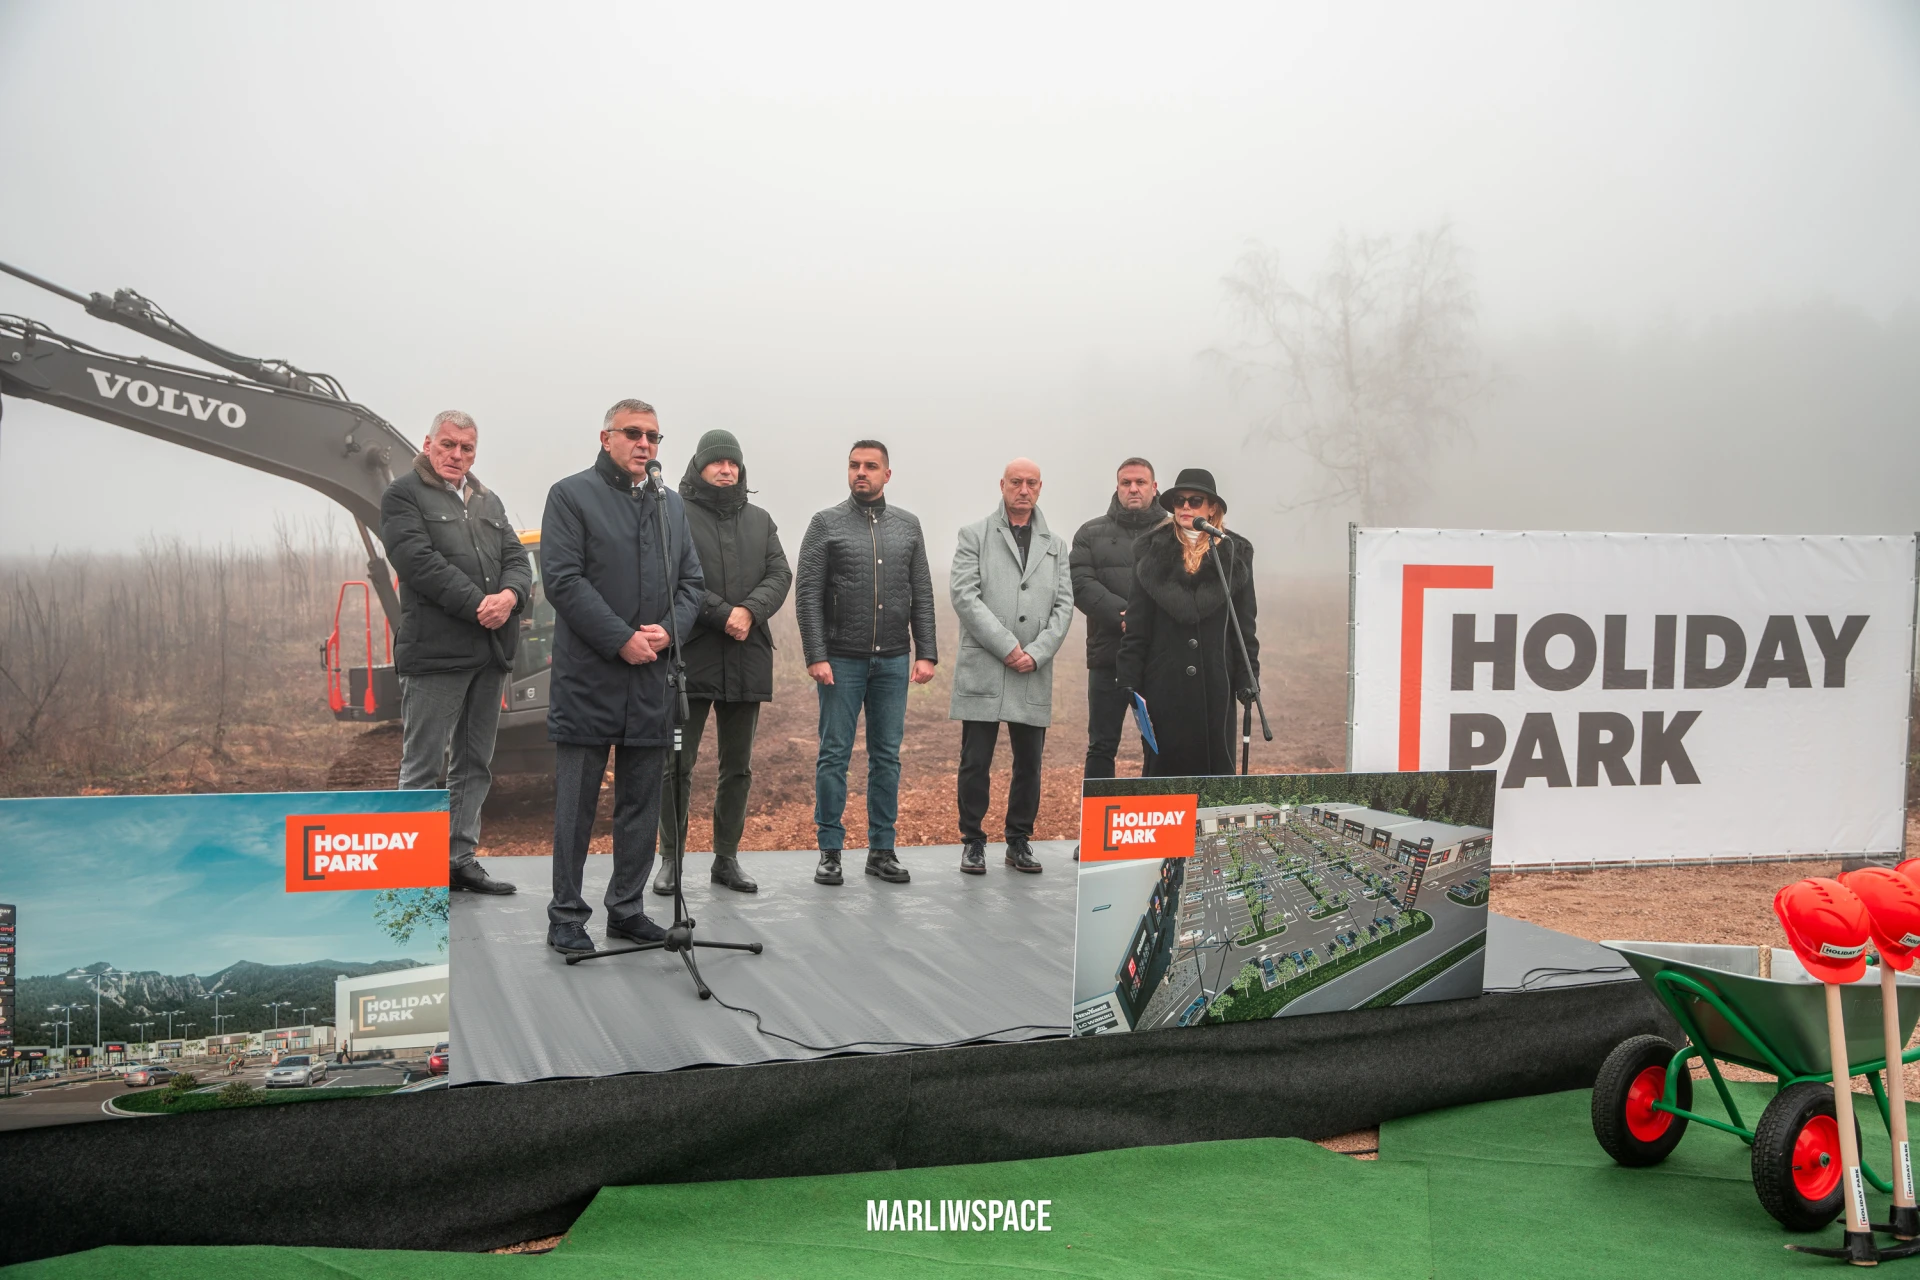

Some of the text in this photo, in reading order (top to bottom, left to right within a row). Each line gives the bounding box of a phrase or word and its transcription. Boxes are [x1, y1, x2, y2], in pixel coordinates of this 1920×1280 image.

[86, 367, 247, 429] VOLVO
[1450, 612, 1871, 692] HOLIDAY
[1449, 710, 1703, 789] PARK
[1112, 811, 1186, 828] HOLIDAY
[314, 832, 419, 852] HOLIDAY
[1111, 828, 1157, 845] PARK
[314, 853, 379, 873] PARK
[1825, 947, 1857, 956] HOLIDAY
[367, 992, 446, 1012] HOLIDAY
[367, 1009, 415, 1024] PARK
[1858, 1190, 1867, 1222] HOLIDAY
